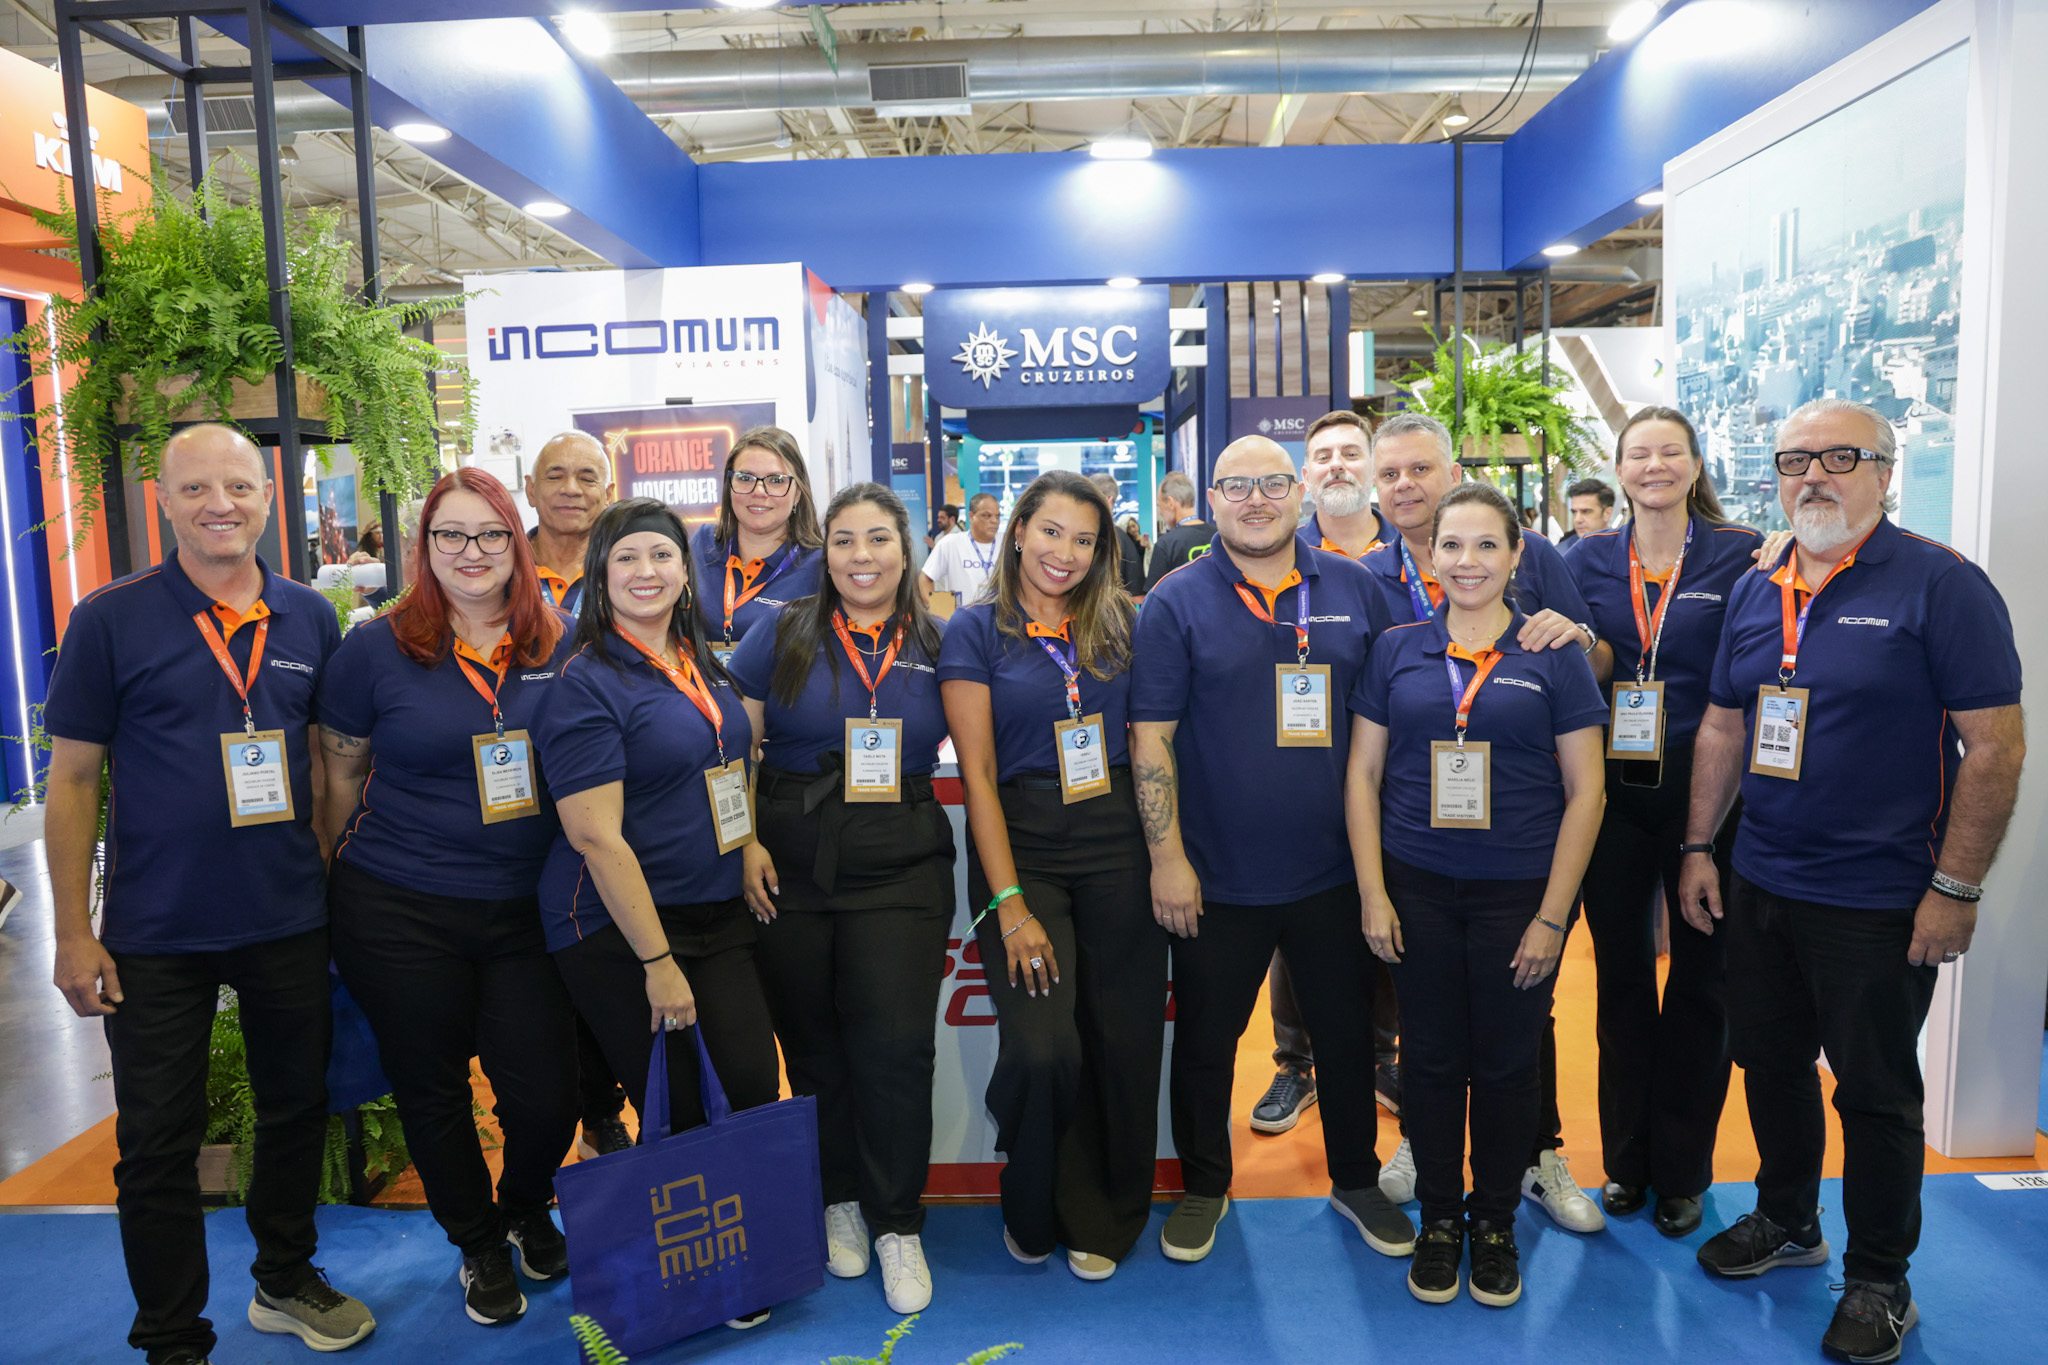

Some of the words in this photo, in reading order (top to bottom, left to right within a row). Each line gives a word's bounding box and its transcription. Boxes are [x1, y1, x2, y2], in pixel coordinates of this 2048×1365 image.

[1019, 324, 1138, 368] MSC
[675, 358, 780, 369] VIAGENS
[1020, 369, 1135, 384] CRUZEIROS
[1273, 418, 1305, 431] MSC
[634, 438, 715, 474] ORANGE
[632, 477, 718, 506] NOVEMBER
[662, 1255, 749, 1289] VIAGENS
